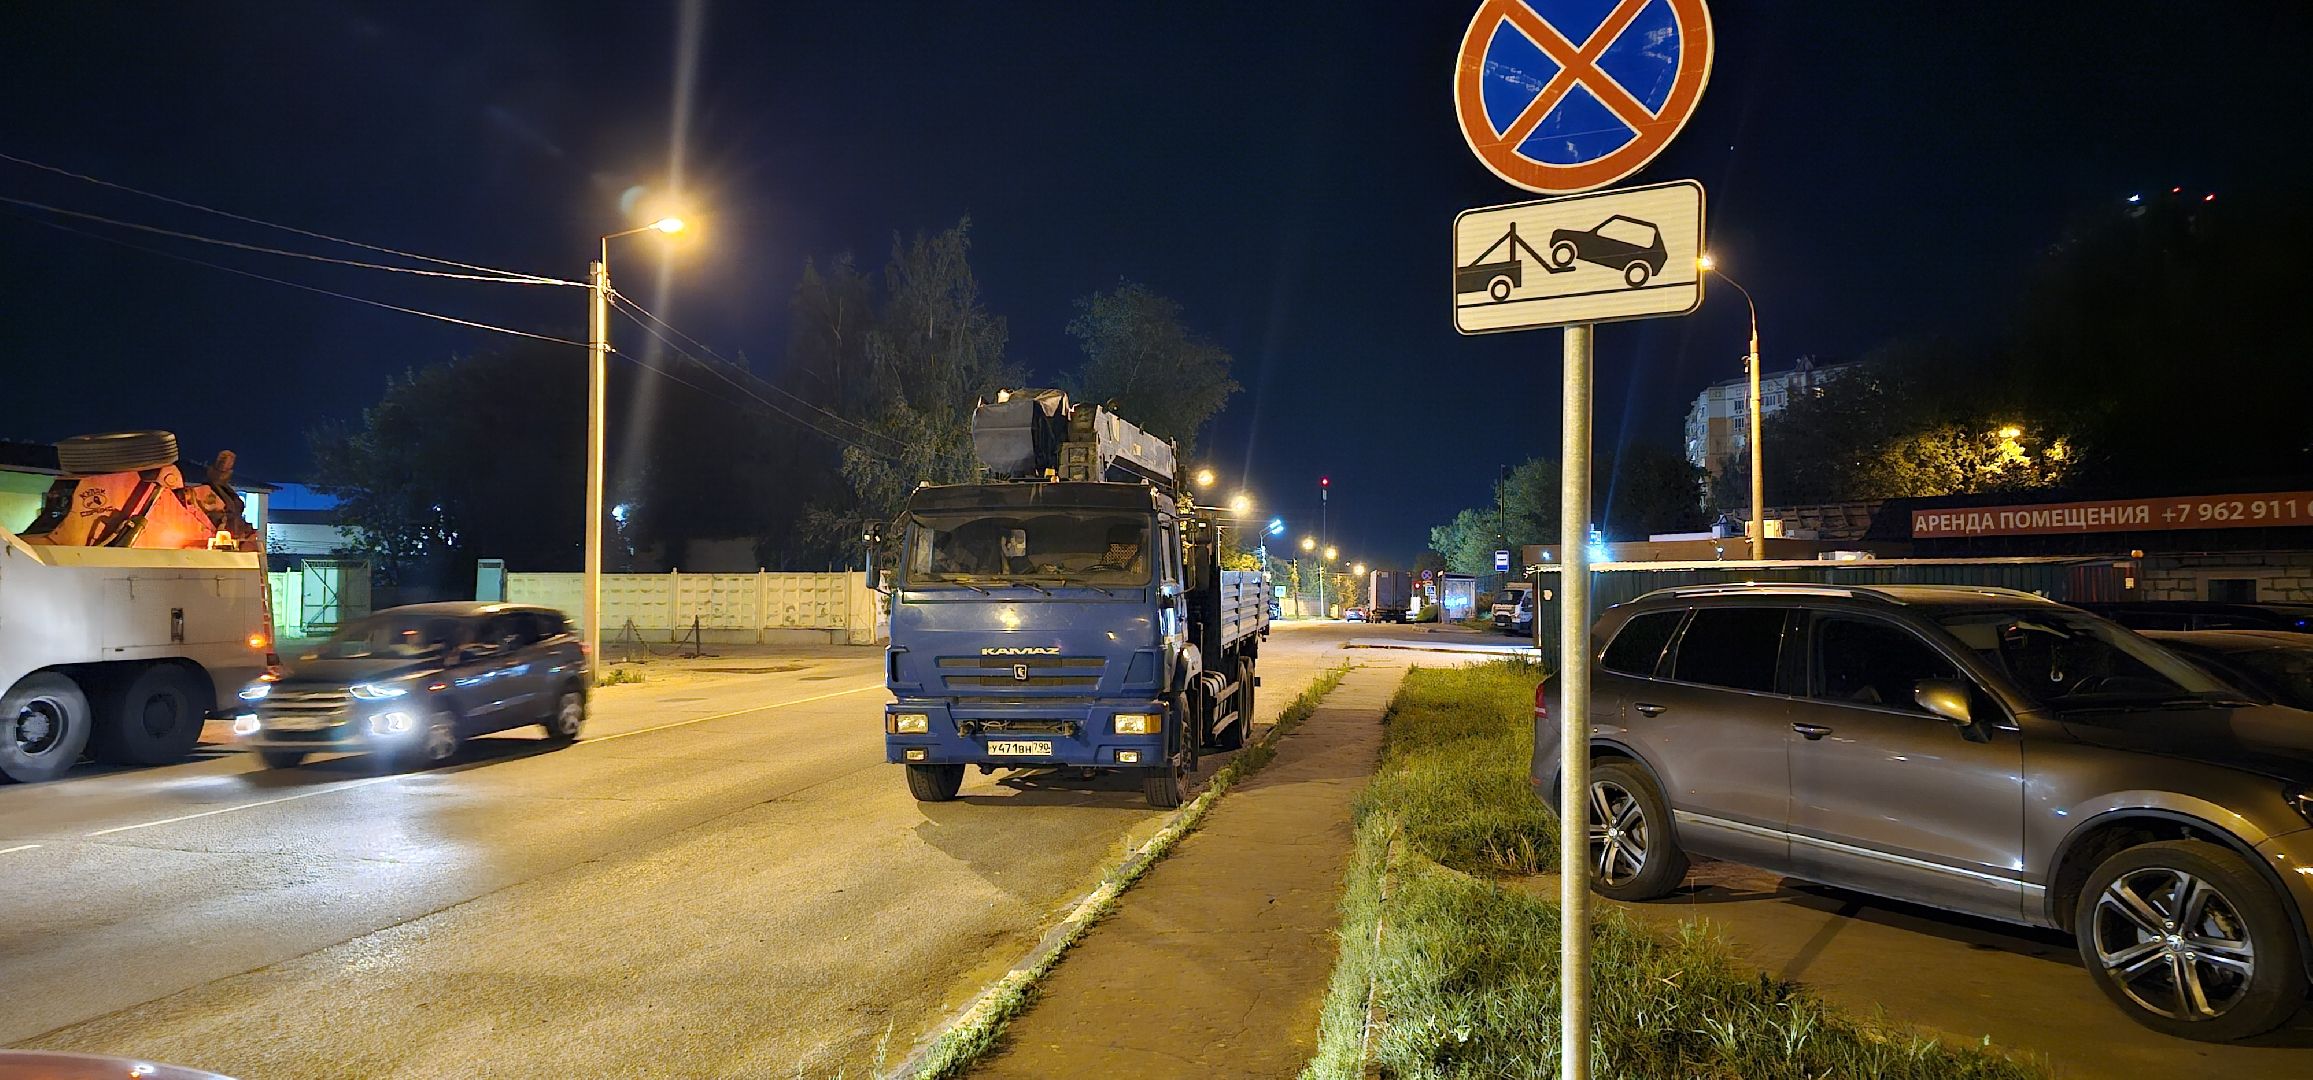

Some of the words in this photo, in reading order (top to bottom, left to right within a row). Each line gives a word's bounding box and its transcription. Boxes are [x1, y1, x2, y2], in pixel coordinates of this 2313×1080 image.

[1915, 512, 1995, 533] АРЕНДА
[2000, 506, 2149, 530] ПОМЕЩЕНИЯ
[2162, 504, 2191, 523] +7
[2199, 502, 2245, 521] 962
[2251, 500, 2297, 519] 911
[981, 647, 1060, 656] KAMAZ
